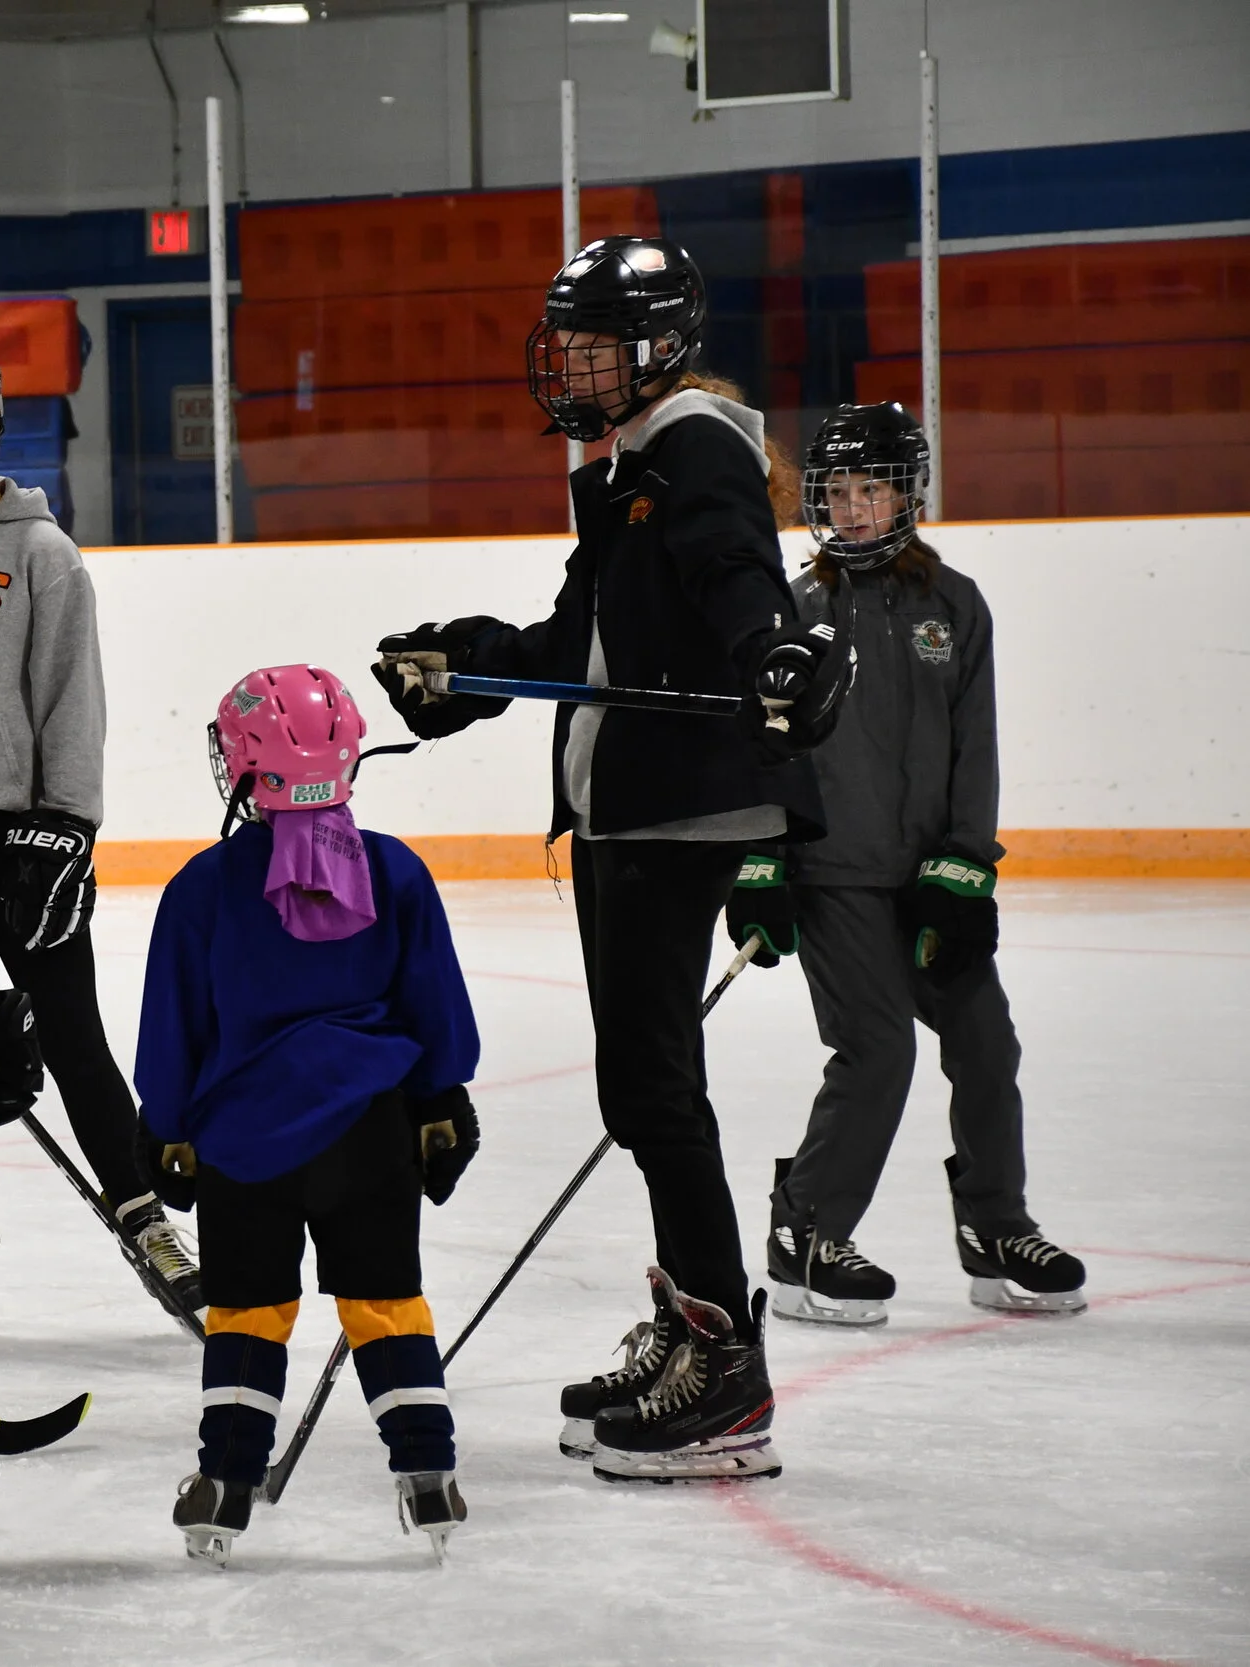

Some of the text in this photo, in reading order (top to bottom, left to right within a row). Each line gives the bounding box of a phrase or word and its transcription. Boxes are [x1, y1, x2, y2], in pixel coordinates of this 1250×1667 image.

[650, 297, 684, 310] BAUER
[826, 441, 864, 451] CCM
[296, 781, 331, 792] SHE
[294, 793, 330, 803] DID
